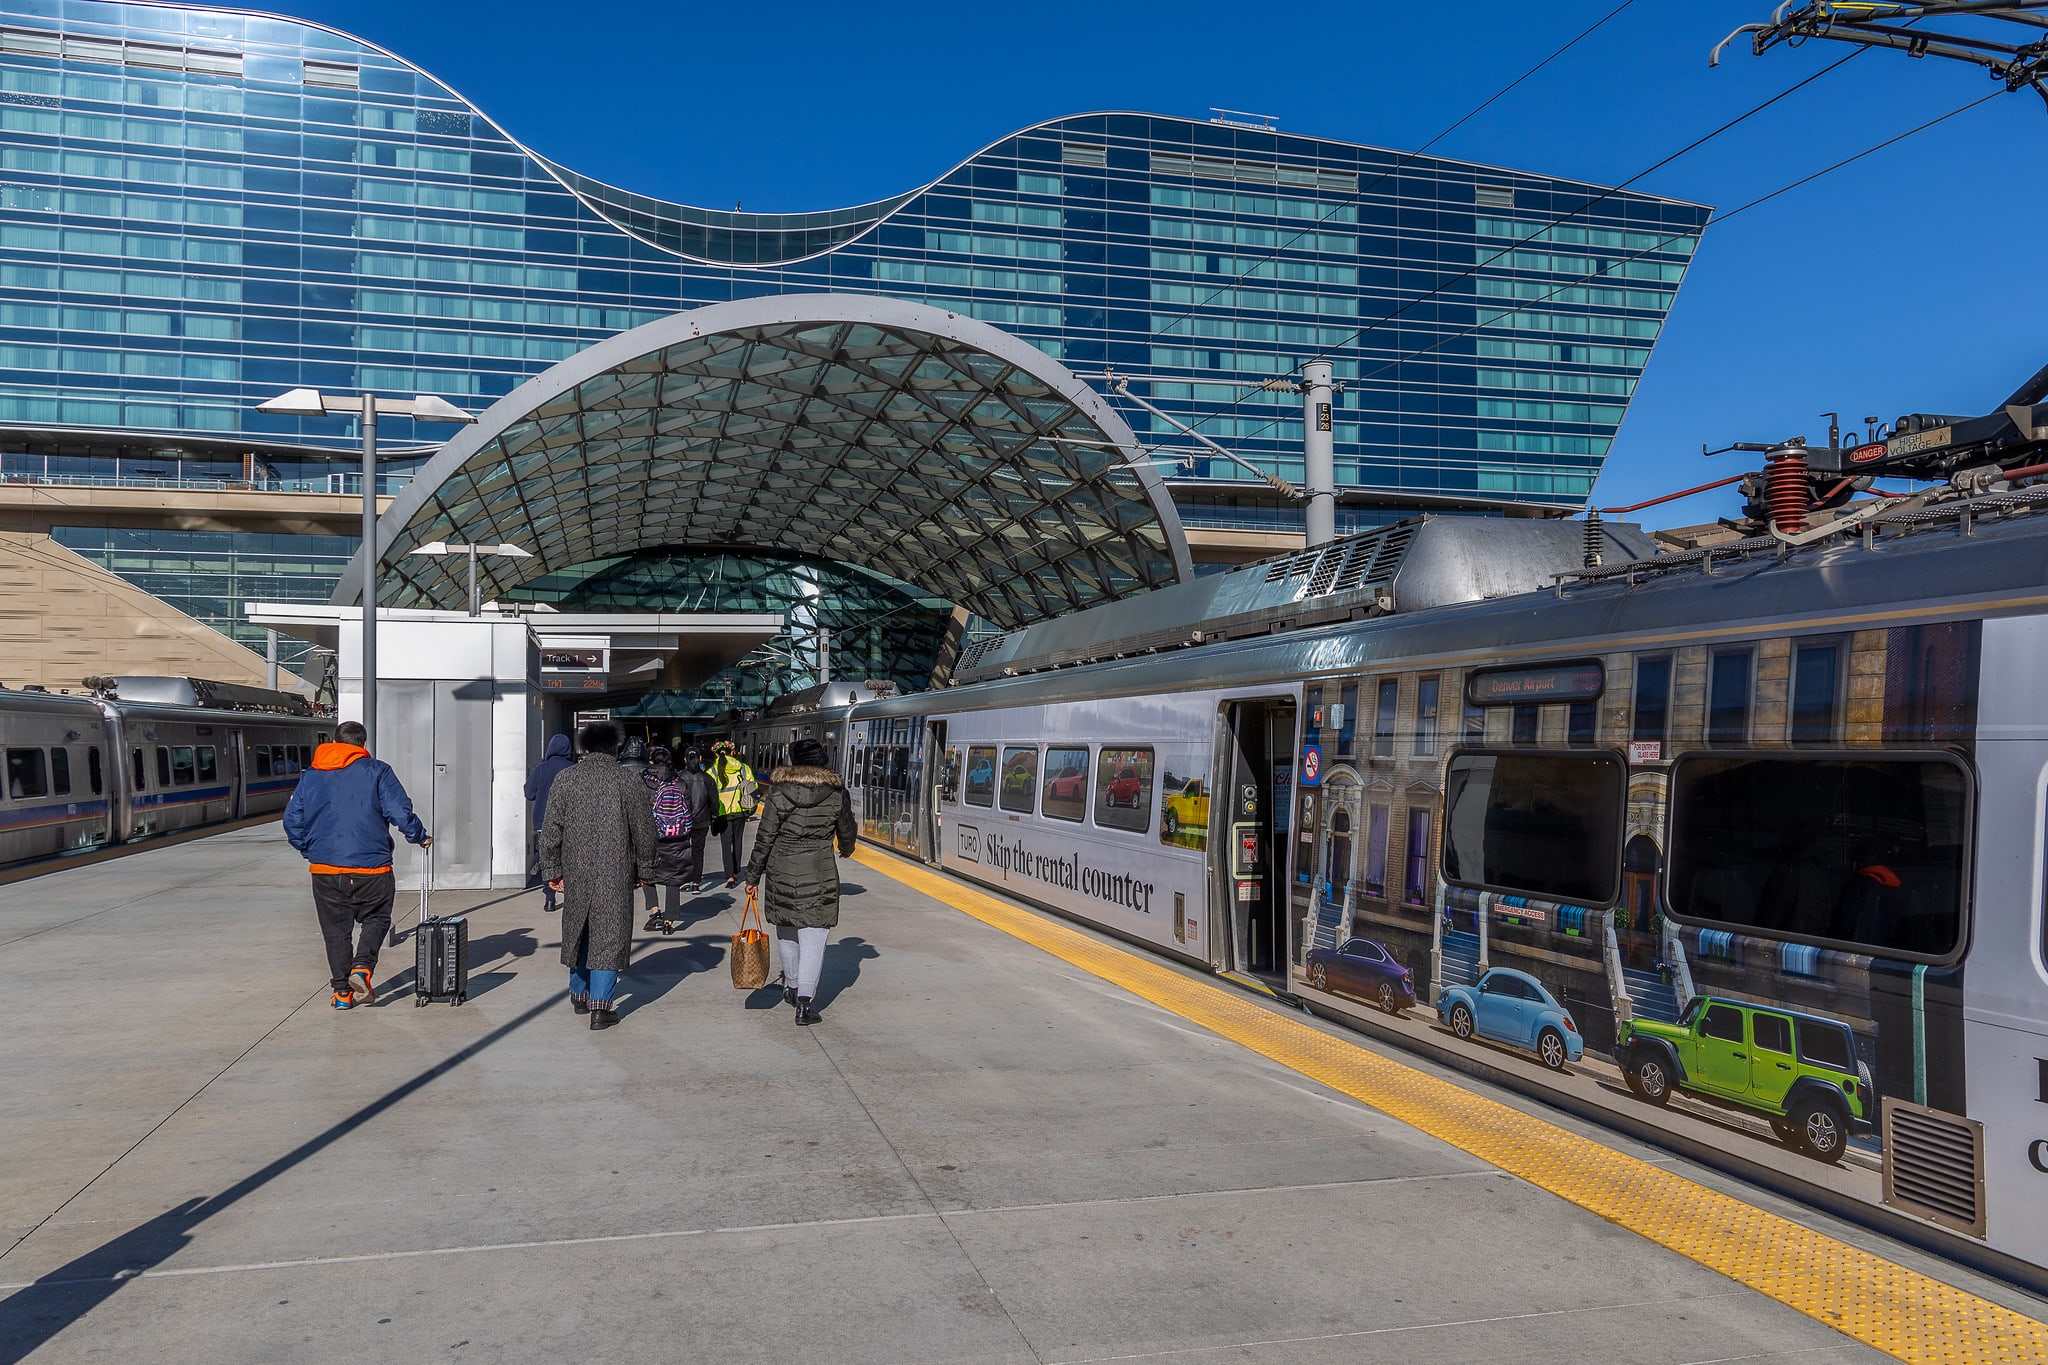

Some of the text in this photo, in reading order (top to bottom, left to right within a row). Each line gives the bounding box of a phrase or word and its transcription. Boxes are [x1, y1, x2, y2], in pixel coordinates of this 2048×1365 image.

[1321, 422, 1329, 430] 26
[1899, 434, 1922, 446] HIGH
[1853, 447, 1883, 460] DANGER
[1889, 440, 1931, 456] VOLTAGE
[1492, 677, 1555, 692] Denver Airport
[665, 824, 680, 837] Hi
[960, 833, 977, 853] TURO
[986, 833, 1154, 914] Skip the rental counter
[1525, 910, 1544, 919] ACCESS
